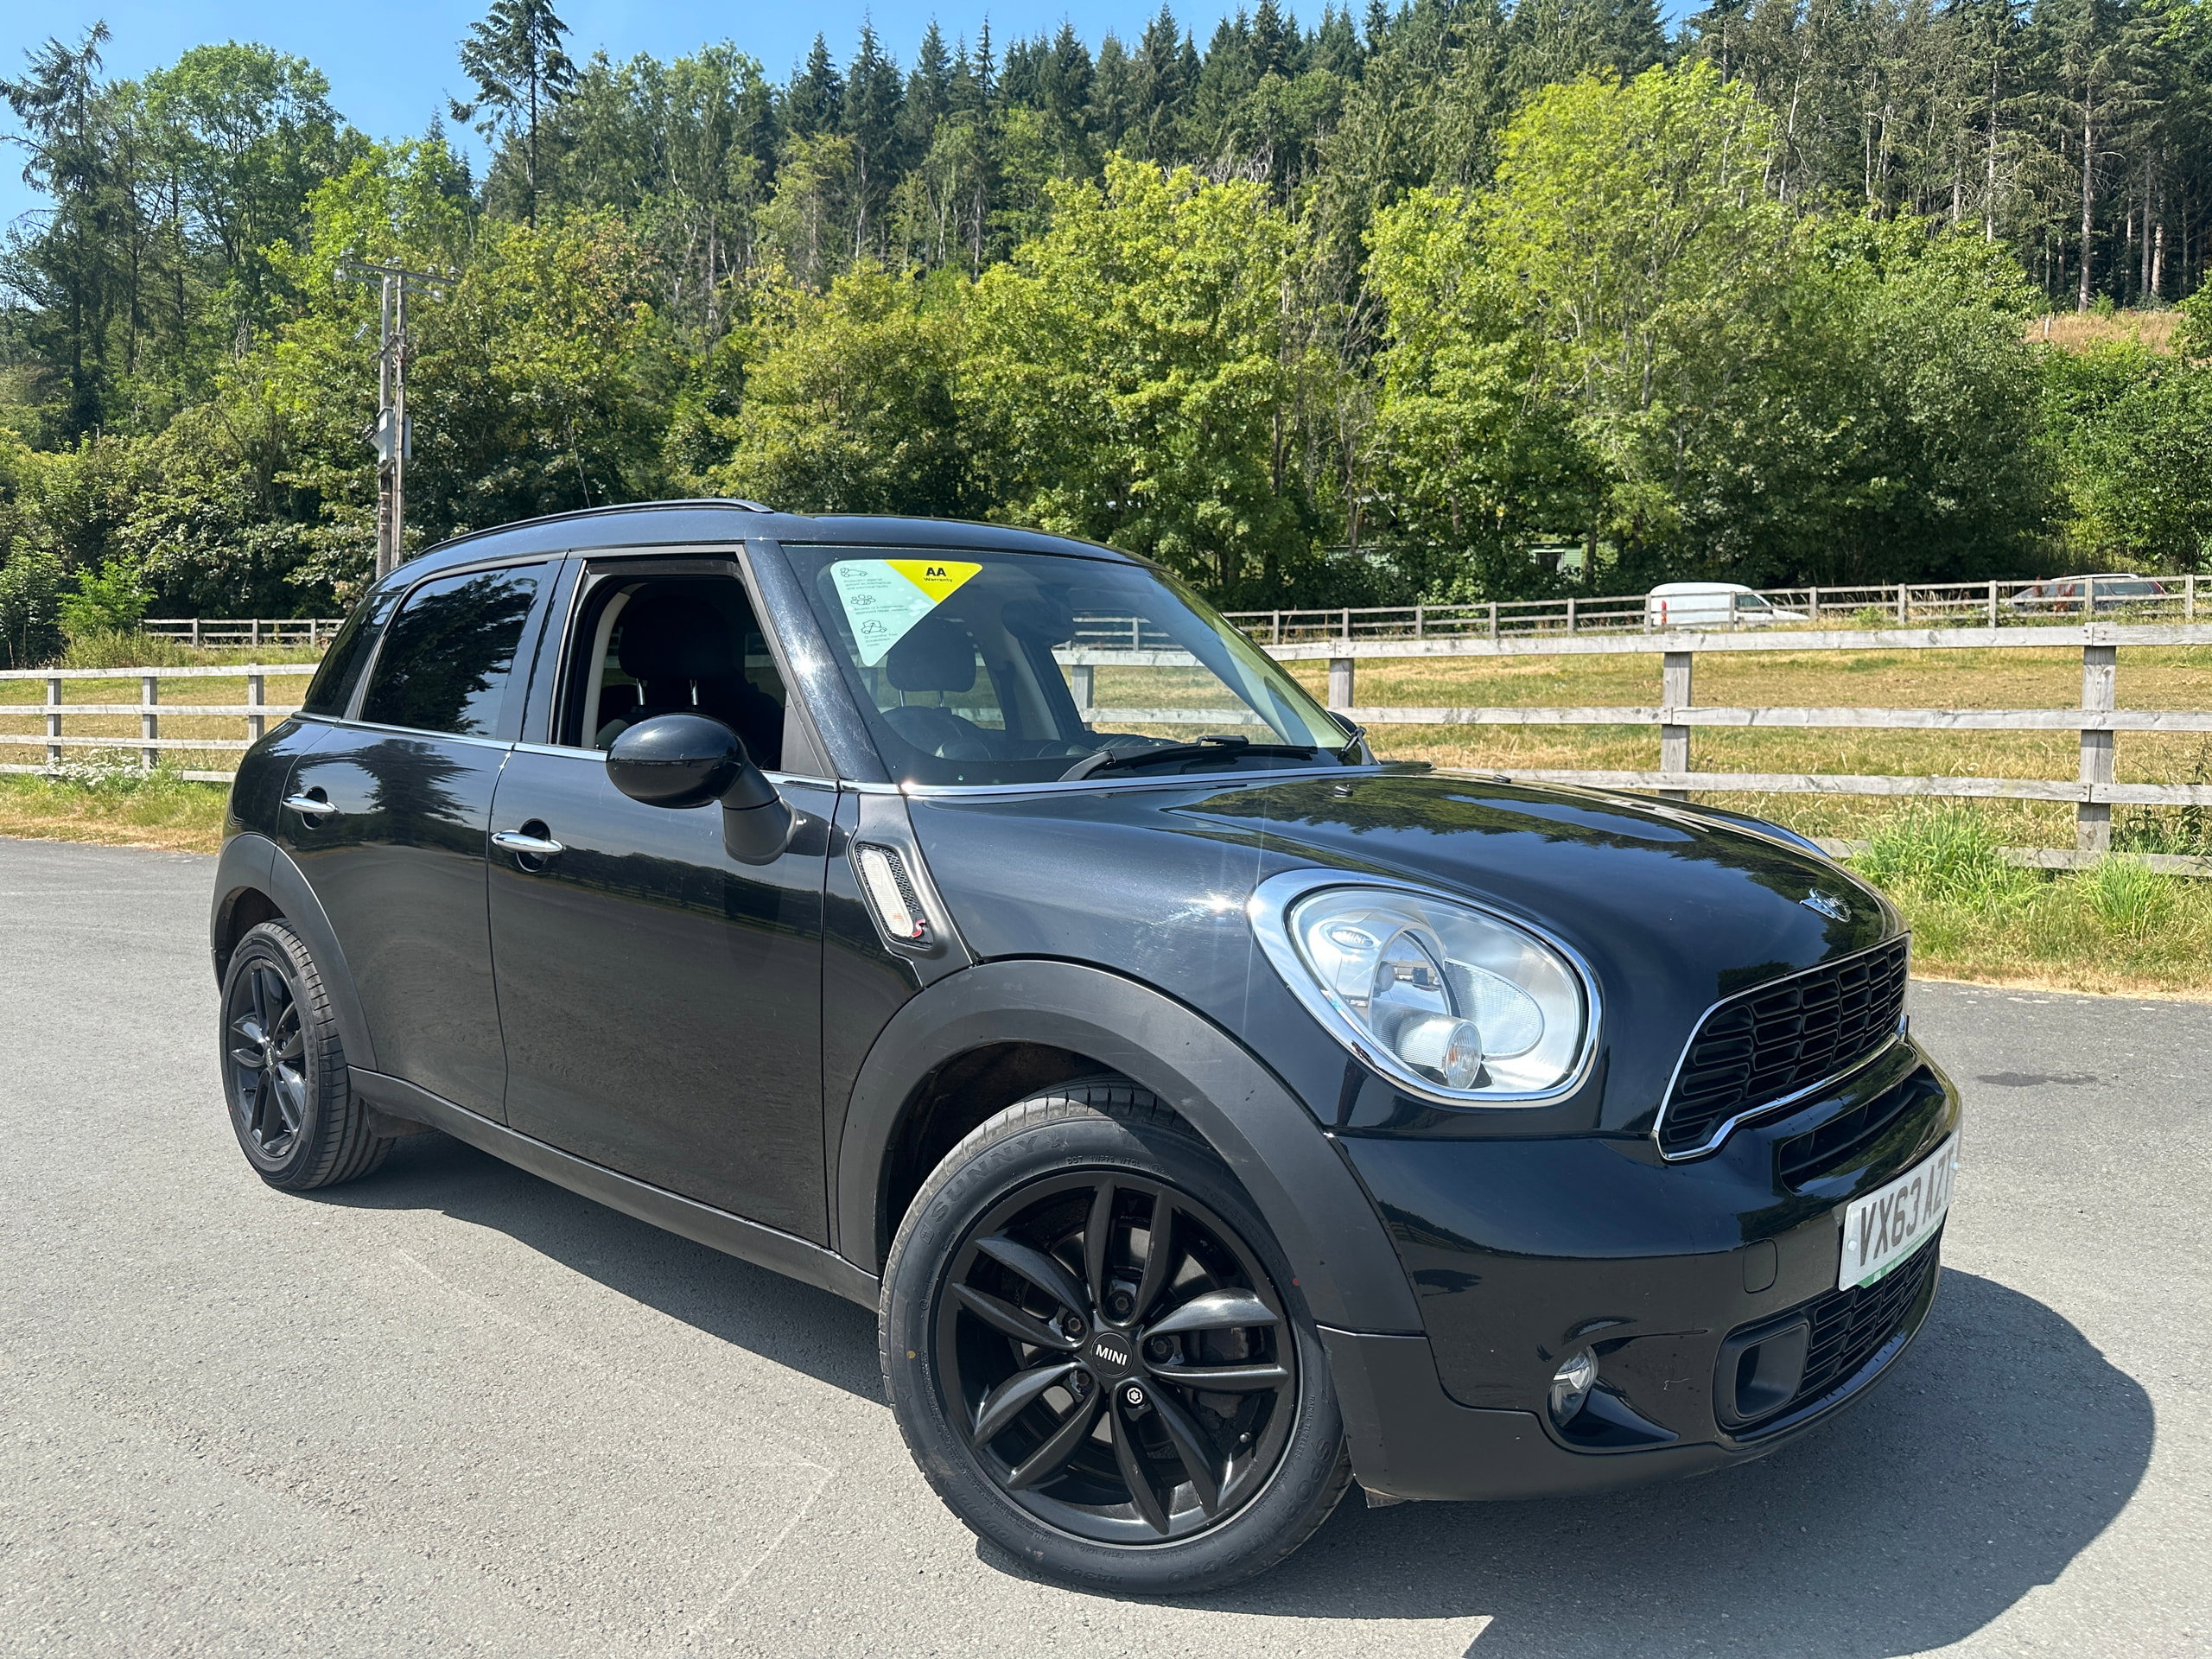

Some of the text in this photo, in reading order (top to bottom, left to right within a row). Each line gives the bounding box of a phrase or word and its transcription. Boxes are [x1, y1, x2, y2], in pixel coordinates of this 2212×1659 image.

[925, 567, 947, 577] AA
[931, 1135, 1039, 1224] SUNNY
[1859, 1176, 1922, 1267] VX63
[1922, 1145, 1955, 1225] AZT
[1095, 1344, 1128, 1366] MINI
